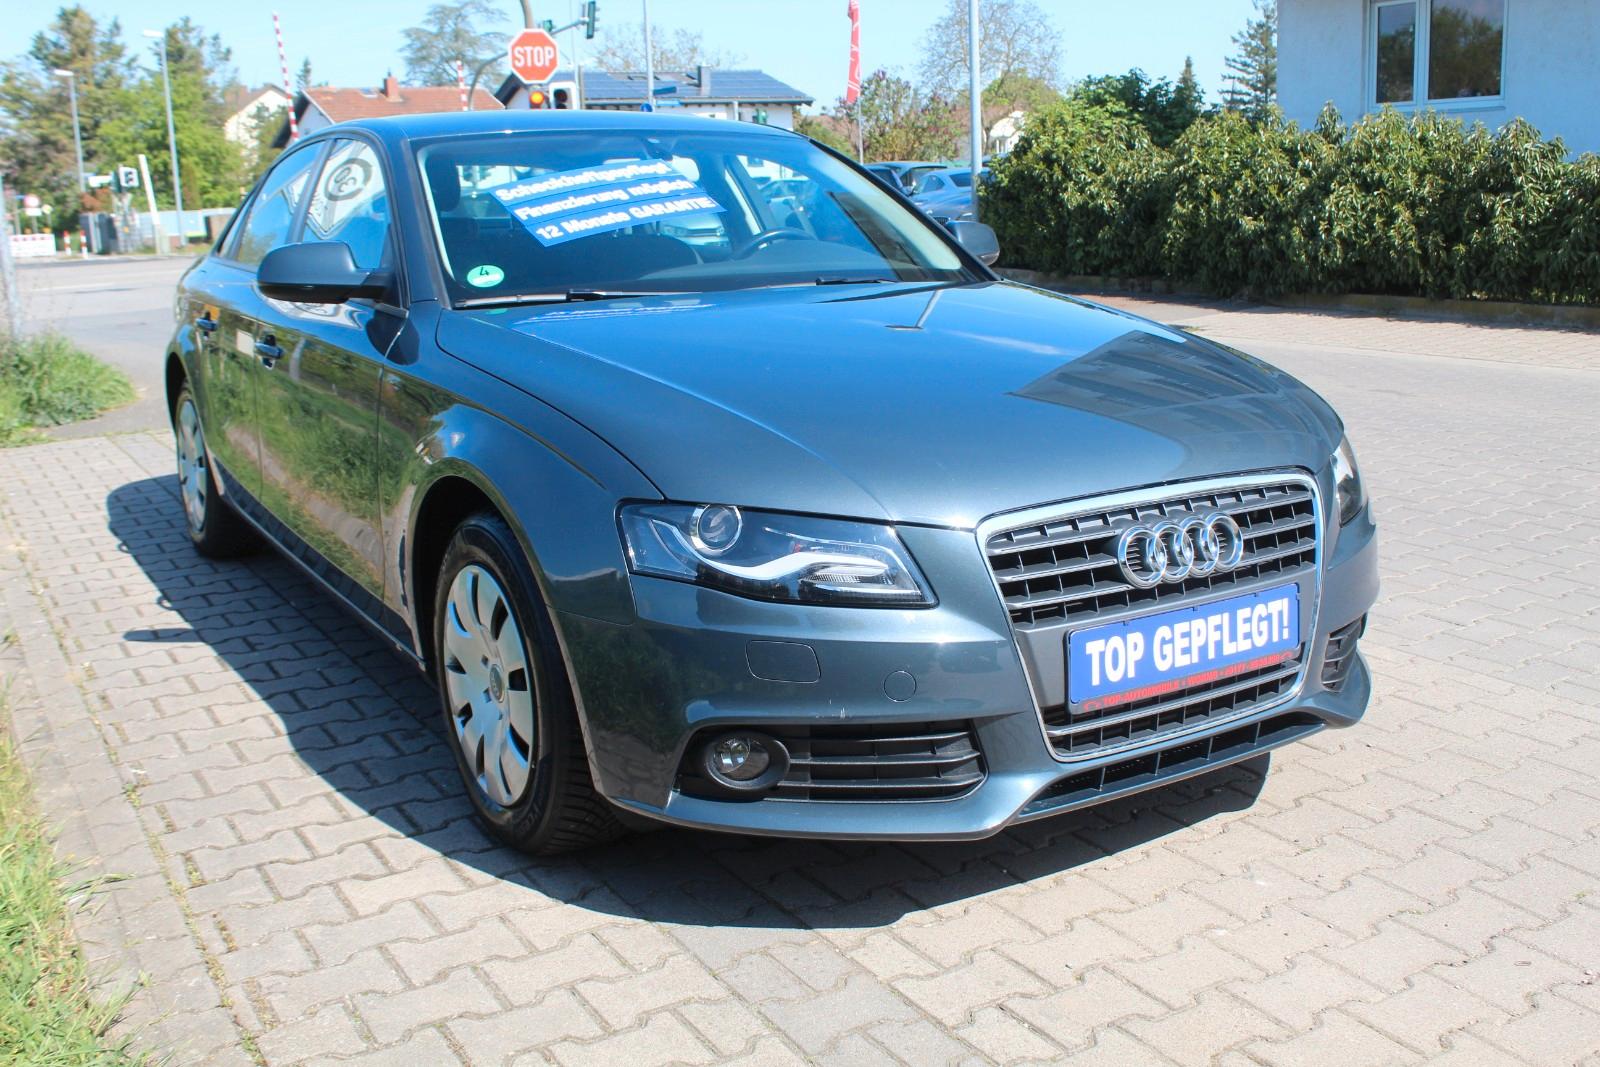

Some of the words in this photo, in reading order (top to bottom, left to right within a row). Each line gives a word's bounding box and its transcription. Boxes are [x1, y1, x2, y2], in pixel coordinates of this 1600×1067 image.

[514, 46, 554, 68] STOP
[514, 189, 630, 220] Finanzierung
[627, 179, 695, 198] möglich
[536, 225, 564, 240] 12
[561, 210, 631, 234] Monate
[629, 196, 718, 219] GARANTIE
[1086, 632, 1144, 686] TOP
[1153, 597, 1289, 672] GEPFLEGT!
